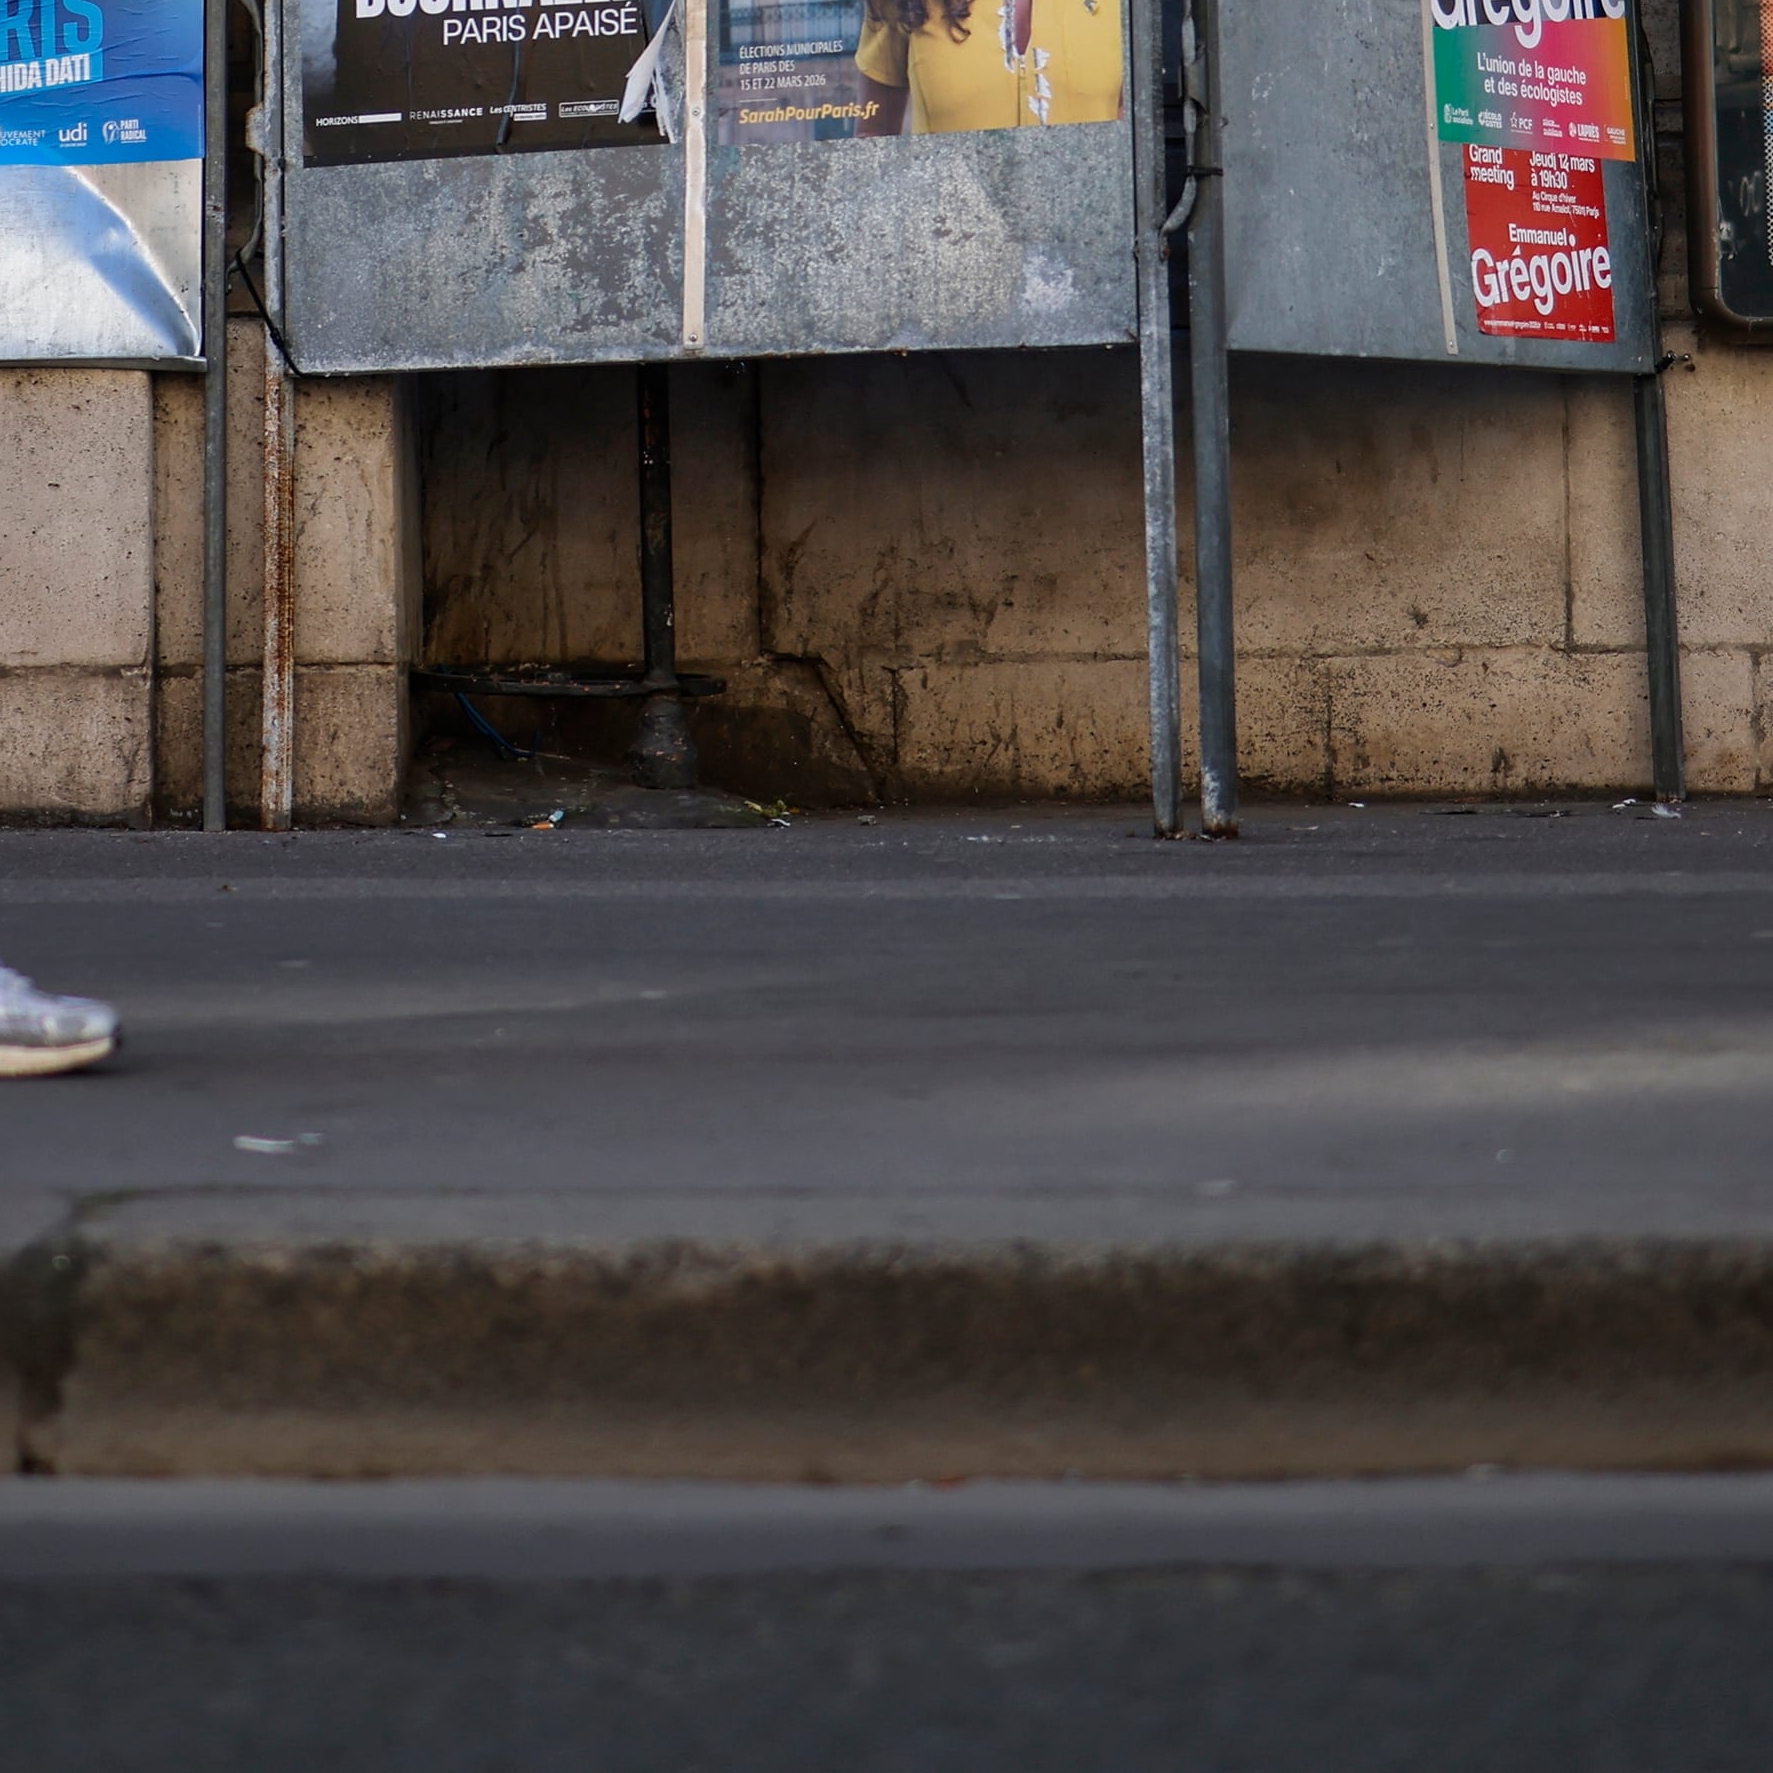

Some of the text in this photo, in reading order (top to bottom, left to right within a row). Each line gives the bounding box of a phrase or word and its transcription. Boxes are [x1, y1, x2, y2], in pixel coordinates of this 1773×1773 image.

[444, 2, 637, 45] PARIS APAISÉ
[46, 54, 90, 85] DATI
[1478, 52, 1586, 85] L'union de la gauche
[1485, 78, 1582, 105] et des écologistes
[316, 116, 358, 126] HORIZONS
[410, 108, 482, 119] RENAISSANCE
[739, 101, 880, 125] SarahPourParis.fr
[59, 122, 87, 142] udi
[1469, 144, 1502, 164] Grand
[1530, 151, 1556, 170] Jeudi
[1571, 158, 1595, 172] mars
[1471, 166, 1514, 190] meeting
[1531, 170, 1567, 189] à 19h30
[1509, 224, 1567, 245] Emmanuel
[1471, 234, 1612, 315] Grégoire
